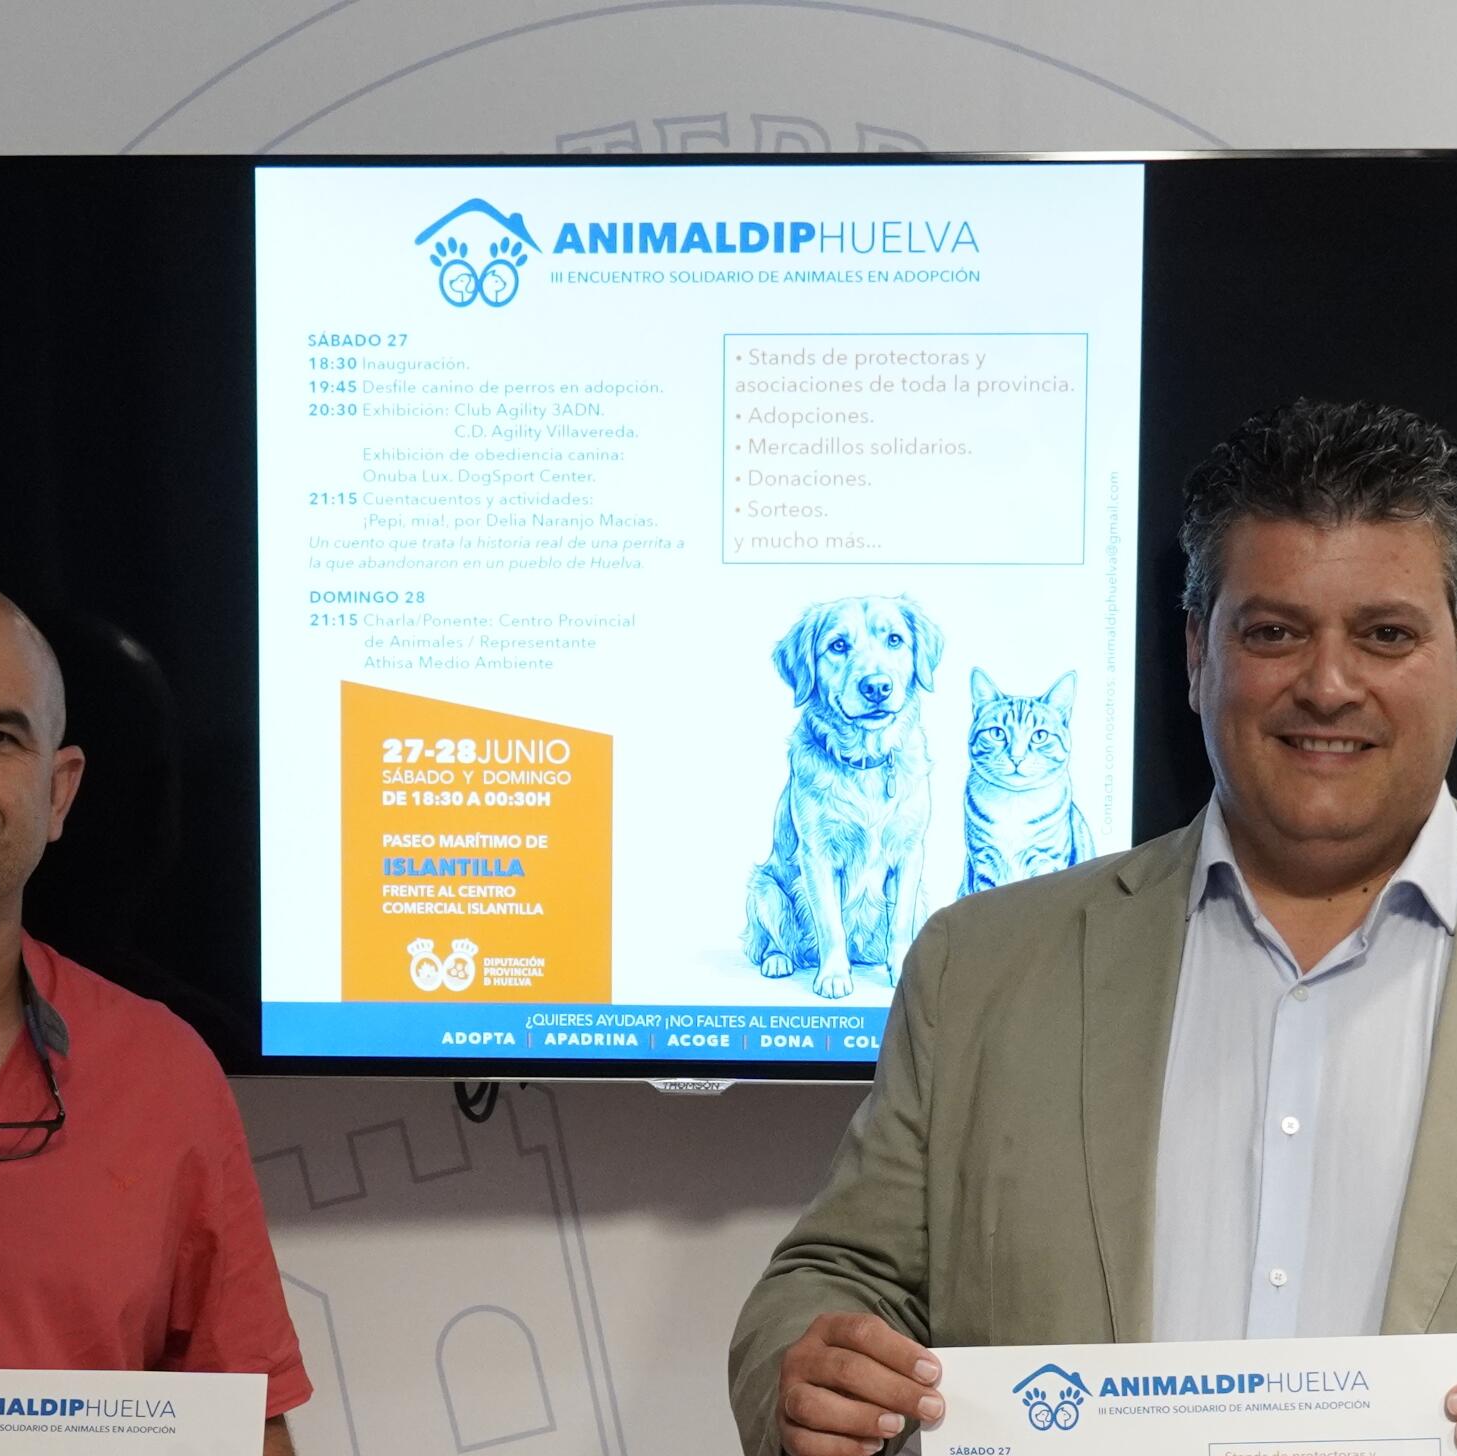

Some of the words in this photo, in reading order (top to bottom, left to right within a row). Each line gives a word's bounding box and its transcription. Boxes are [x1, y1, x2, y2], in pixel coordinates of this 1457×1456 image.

[552, 221, 979, 254] ANIMALDIPHUELVA
[550, 271, 563, 283] III
[567, 270, 665, 284] ENCUENTRO
[668, 270, 754, 283] SOLIDARIO
[758, 270, 779, 283] DE
[783, 270, 863, 284] ANIMALES
[867, 270, 889, 283] EN
[892, 266, 980, 283] ADOPCIÓN
[307, 332, 381, 347] SÁBADO
[387, 332, 408, 347] 27
[748, 347, 816, 366] Stands
[821, 347, 848, 365] de
[854, 350, 969, 370] protectoras
[975, 353, 986, 370] y
[735, 375, 863, 393] asociaciones
[868, 374, 895, 392] de
[900, 373, 946, 392] toda
[954, 373, 970, 392] la
[977, 375, 1074, 397] provincia.
[747, 405, 873, 428] Adopciones.
[748, 436, 864, 455] Mercadillos
[870, 436, 972, 455] solidarios.
[747, 469, 871, 487] Donaciones.
[747, 499, 828, 518] Sorteos.
[733, 536, 744, 553] y
[751, 529, 819, 549] mucho
[825, 531, 881, 549] más...
[309, 590, 399, 604] DOMINGO
[404, 591, 425, 604] 28
[381, 767, 456, 785] SÁBADO
[461, 769, 474, 784] Y
[481, 769, 572, 786] DOMINGO
[381, 790, 407, 806] DE
[411, 790, 464, 806] 18:30
[465, 790, 482, 806] A
[483, 790, 551, 806] 00:30H
[381, 832, 436, 848] PASEO
[437, 831, 524, 849] MARÍTIMO
[523, 833, 548, 849] DE
[383, 857, 525, 877] ISLANTILLA
[441, 1031, 516, 1045] ADOPTA
[544, 1032, 638, 1046] APADRINA
[667, 1033, 730, 1048] ACOGE
[760, 1034, 814, 1048] DONA
[1099, 1370, 1368, 1397] ANIMALDIPHUELVA
[1098, 1407, 1107, 1415] III
[1108, 1405, 1171, 1415] ENCUENTRO
[1172, 1403, 1227, 1414] SOLIDARIO
[1228, 1403, 1242, 1412] DE
[1244, 1401, 1296, 1411] ANIMALES
[1298, 1401, 1312, 1410] EN
[1313, 1399, 1370, 1410] ADOPCIÓN
[949, 1445, 995, 1455] SÁBADO
[998, 1446, 1010, 1455] 27
